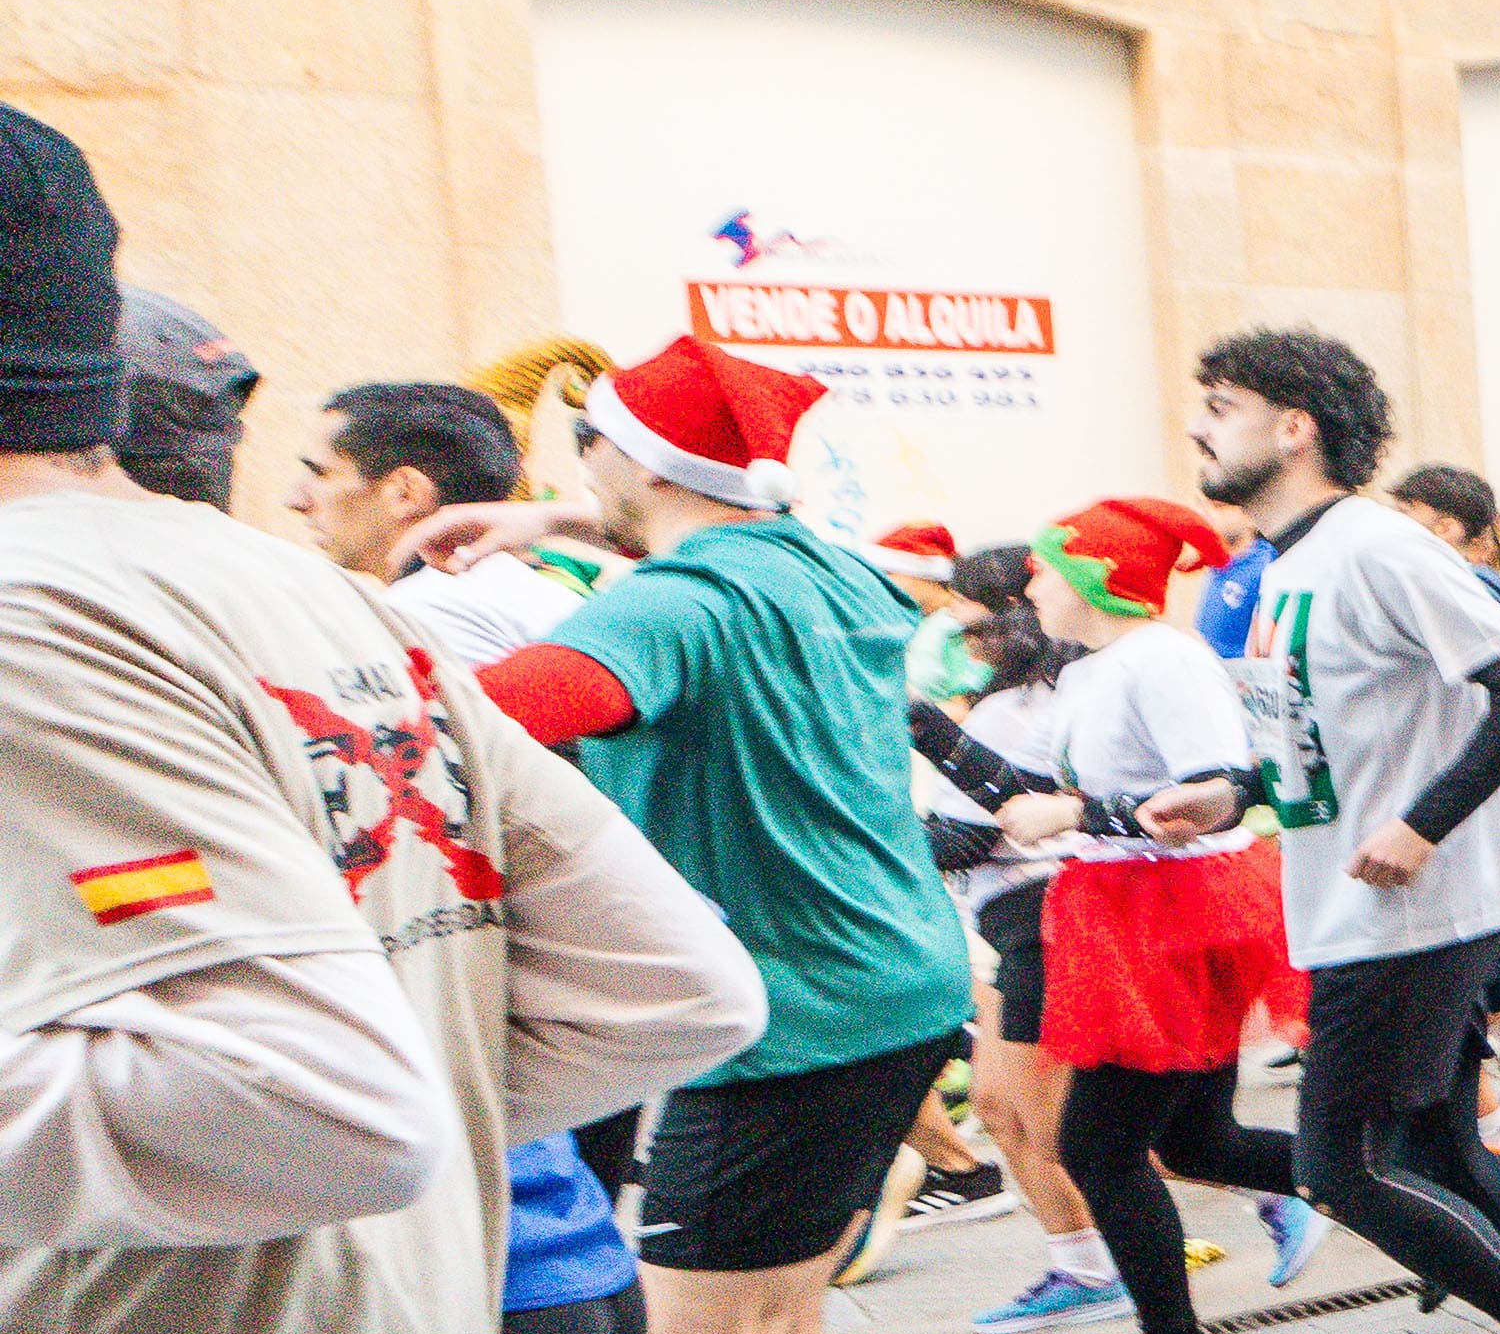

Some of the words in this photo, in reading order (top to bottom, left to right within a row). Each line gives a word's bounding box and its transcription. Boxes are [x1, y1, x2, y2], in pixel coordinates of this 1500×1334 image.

[699, 284, 842, 343] VENDE
[844, 289, 879, 344] O
[883, 293, 1046, 350] ALQUILA
